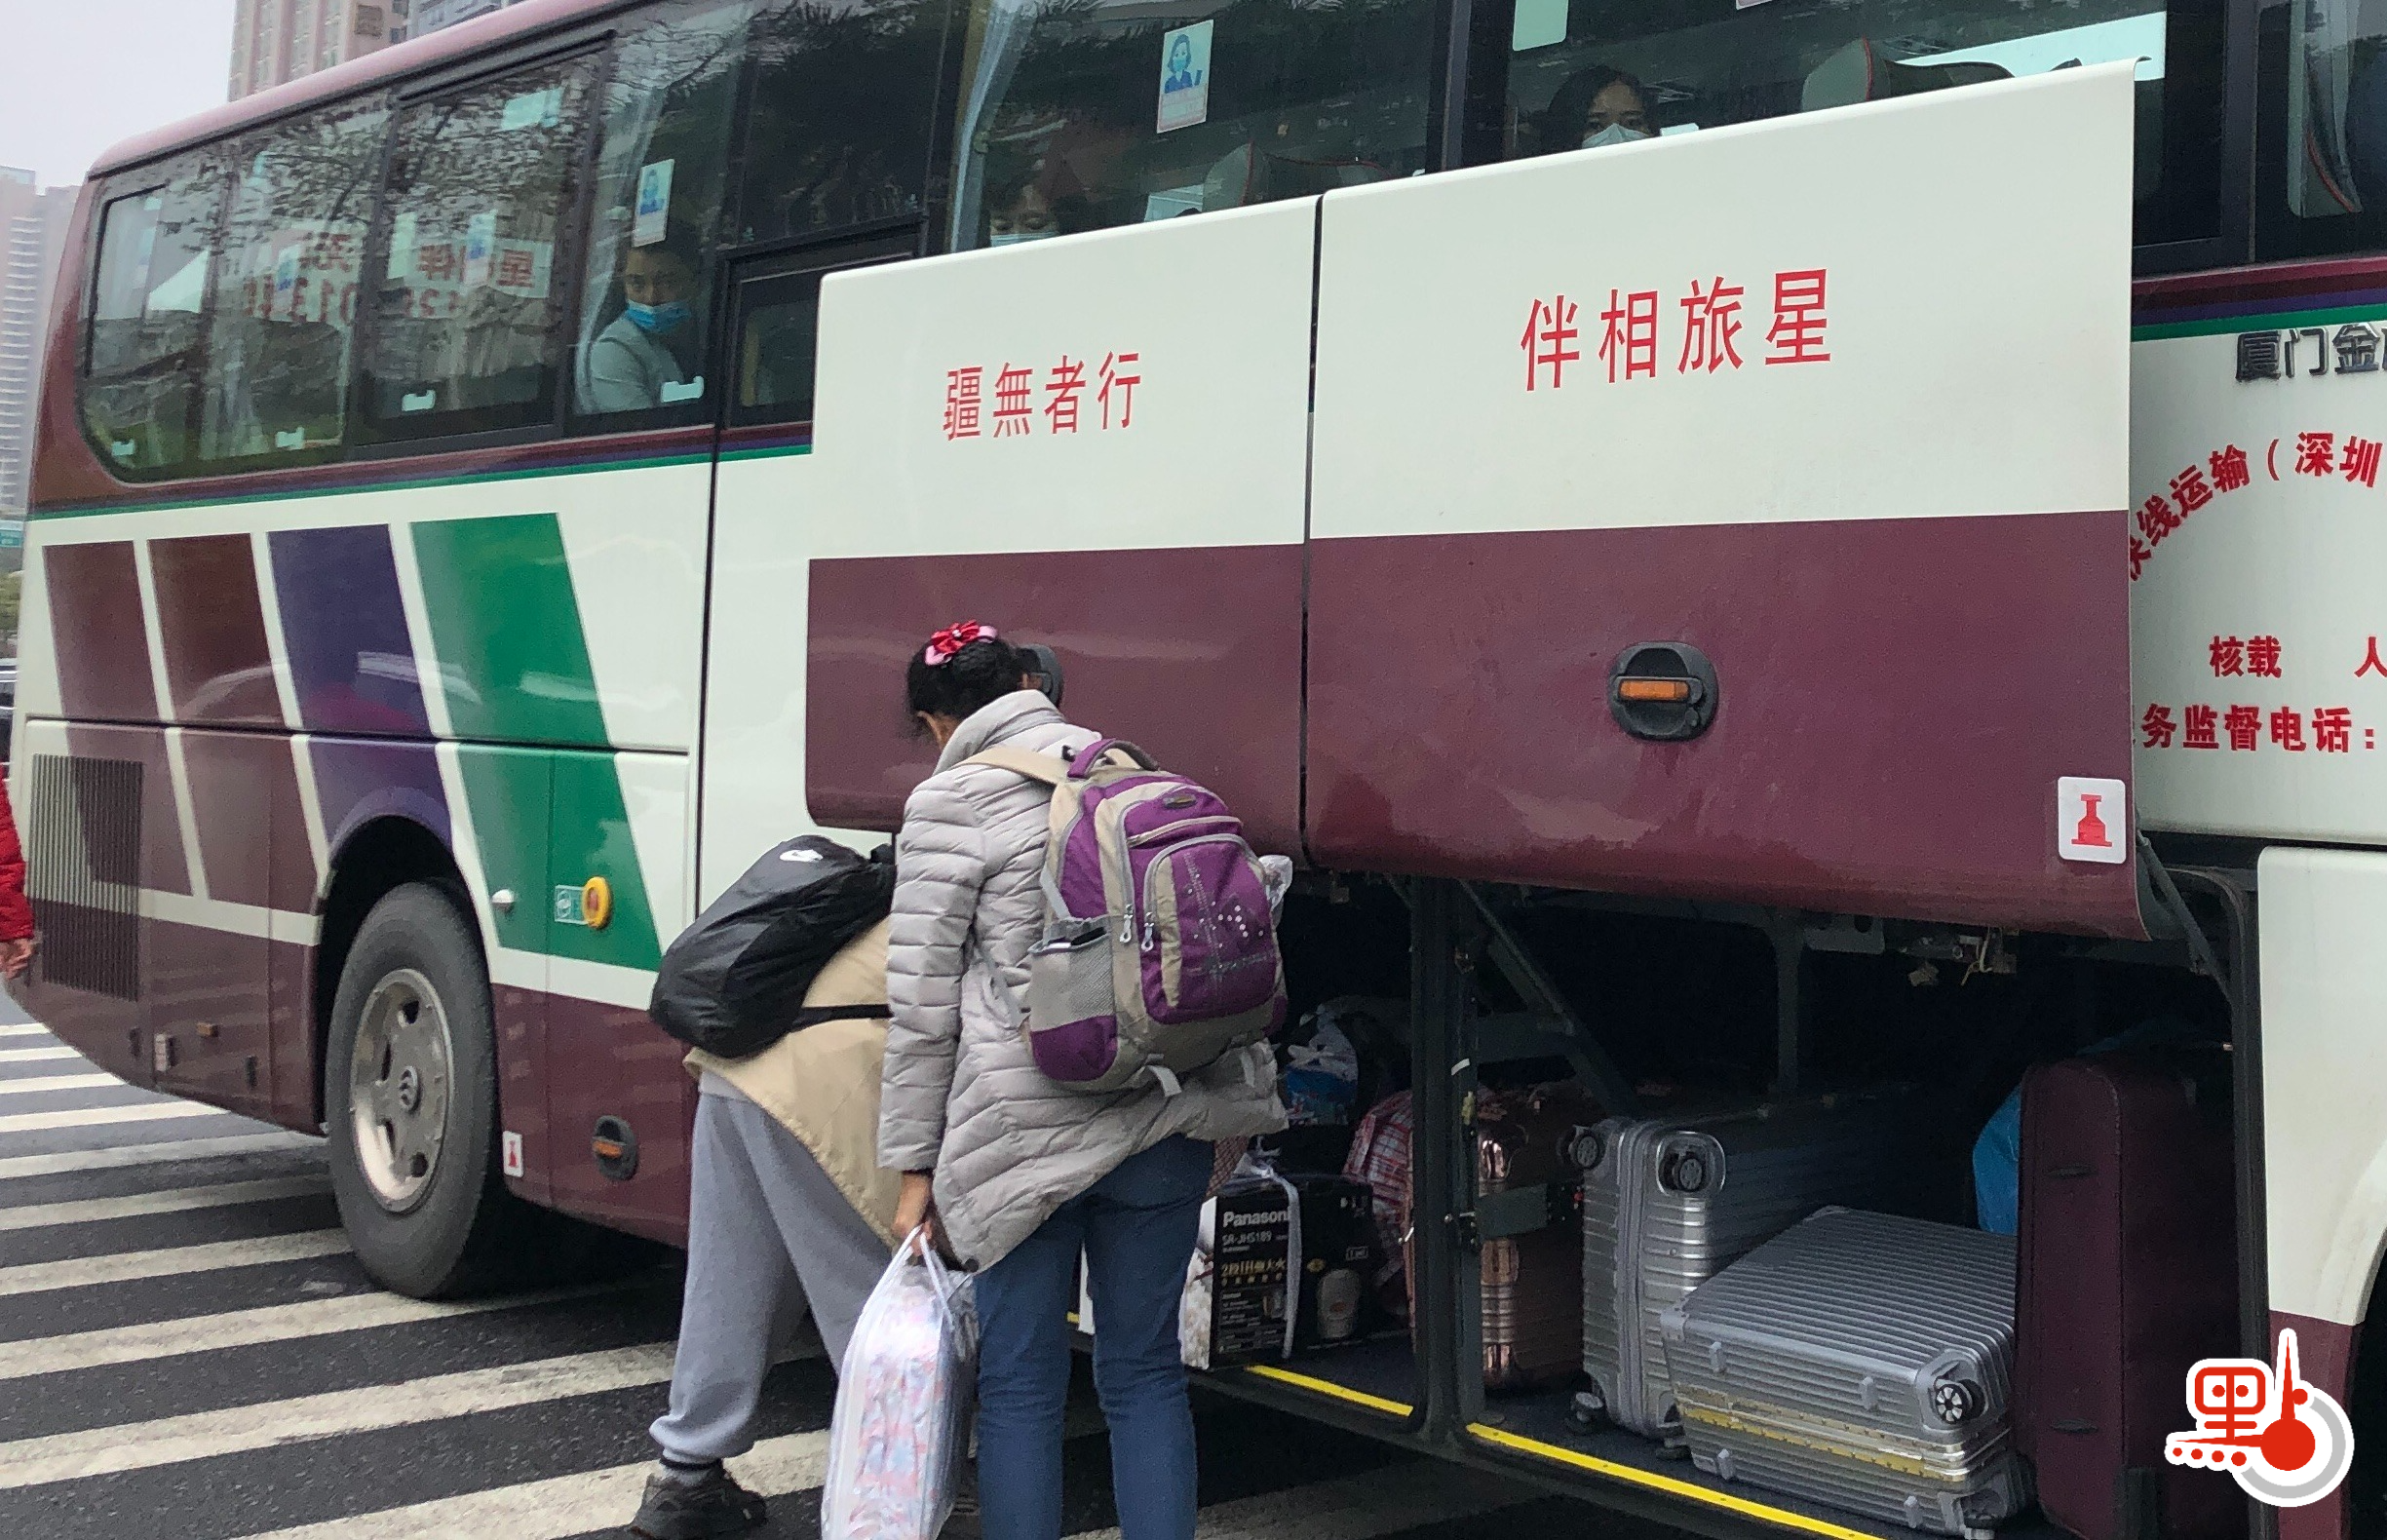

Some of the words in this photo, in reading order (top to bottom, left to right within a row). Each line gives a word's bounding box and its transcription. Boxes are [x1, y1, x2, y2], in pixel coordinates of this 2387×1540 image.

[2236, 322, 2387, 380] 厦门金
[2210, 635, 2283, 678] 核载
[2354, 636, 2387, 677] 人
[2140, 703, 2374, 753] 务监督电话：
[1222, 1211, 1289, 1228] Panason
